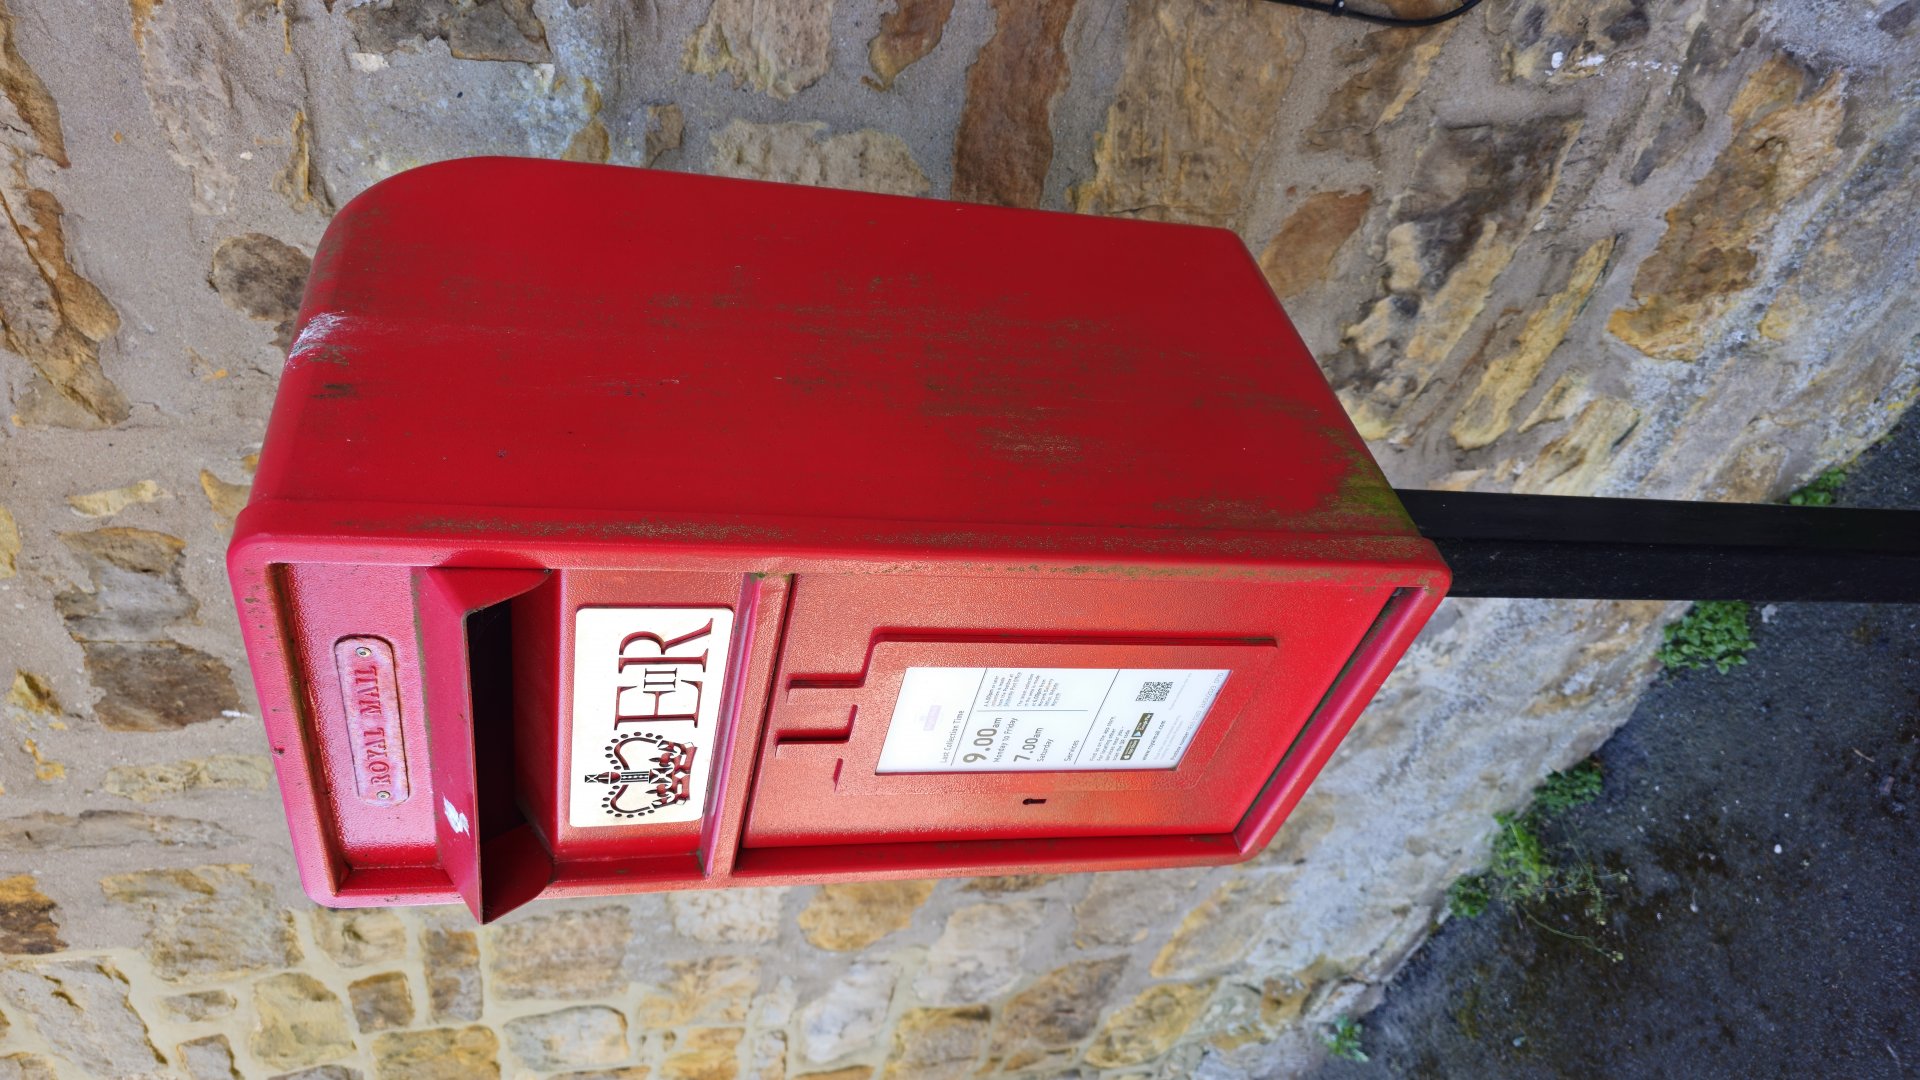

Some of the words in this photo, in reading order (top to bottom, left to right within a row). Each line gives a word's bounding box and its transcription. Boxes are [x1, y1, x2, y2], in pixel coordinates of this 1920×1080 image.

[354, 665, 382, 714] MAIL
[953, 710, 964, 723] Time
[944, 725, 959, 750] Collection
[963, 717, 1002, 763] 9.00am
[993, 743, 1008, 762] Monday
[1004, 718, 1018, 734] Friday
[1013, 727, 1044, 762] 7.00am
[1037, 739, 1053, 761] Saturday
[1064, 740, 1079, 761] Services
[363, 727, 391, 785] ROYAL
[941, 752, 950, 763] Last
